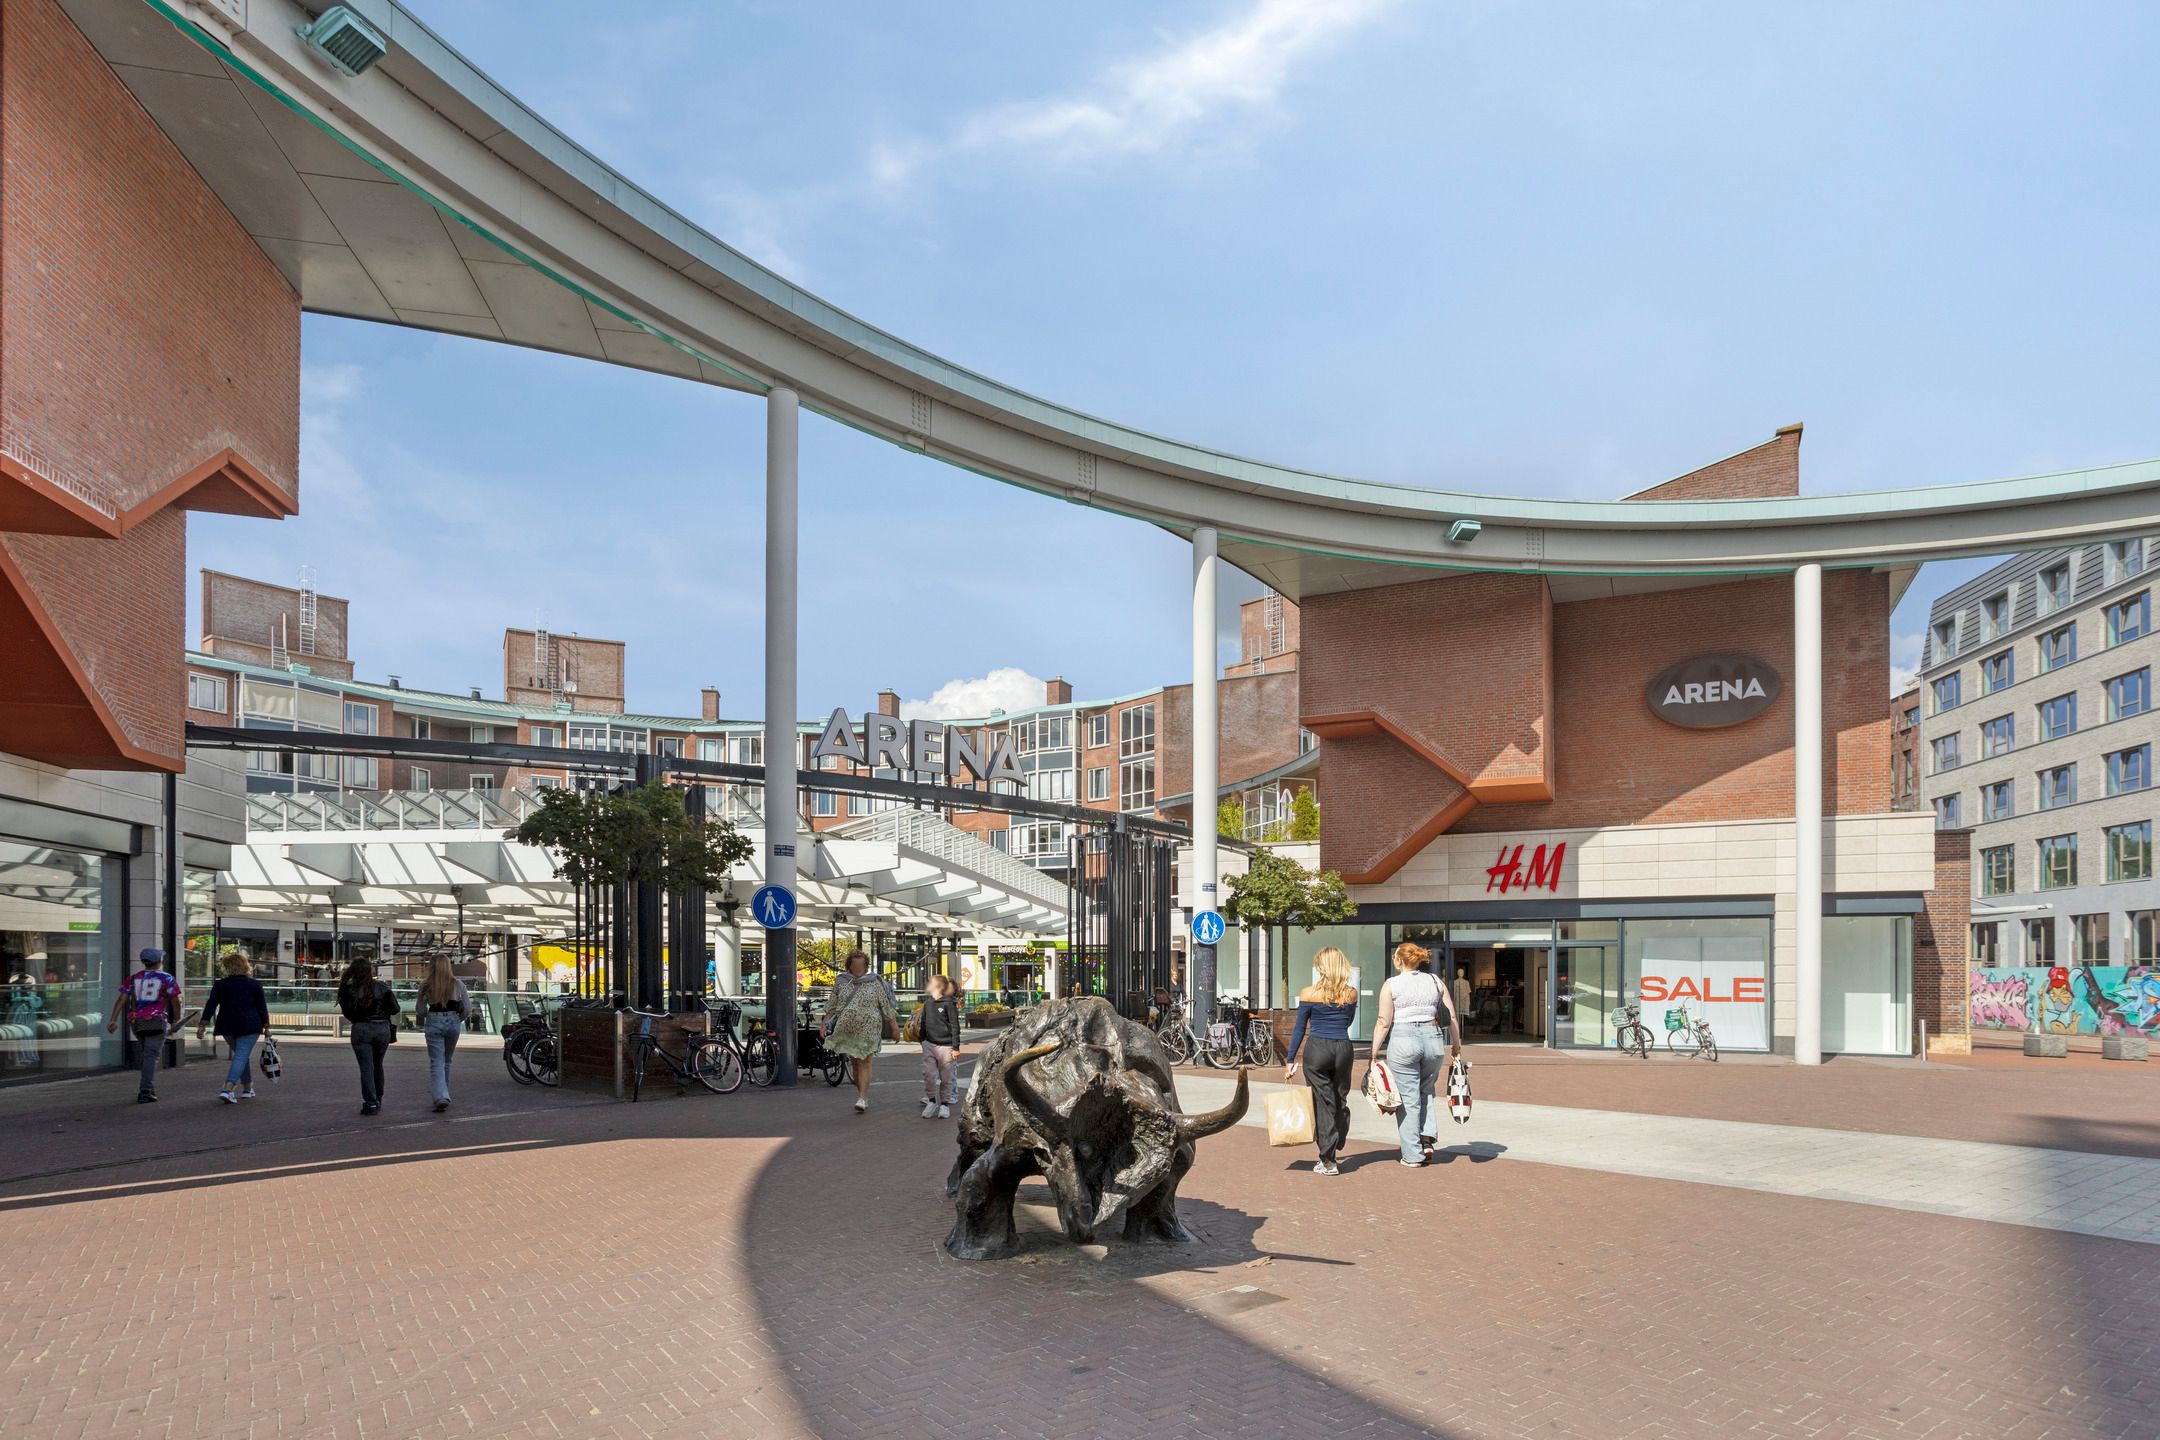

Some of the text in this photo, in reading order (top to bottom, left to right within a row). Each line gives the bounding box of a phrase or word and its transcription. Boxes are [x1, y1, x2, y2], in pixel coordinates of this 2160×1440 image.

[1662, 677, 1766, 706] ARENA
[813, 708, 1028, 786] ARENA
[1486, 842, 1567, 893] H&M
[134, 976, 162, 1001] 18
[1640, 976, 1765, 1002] SALE
